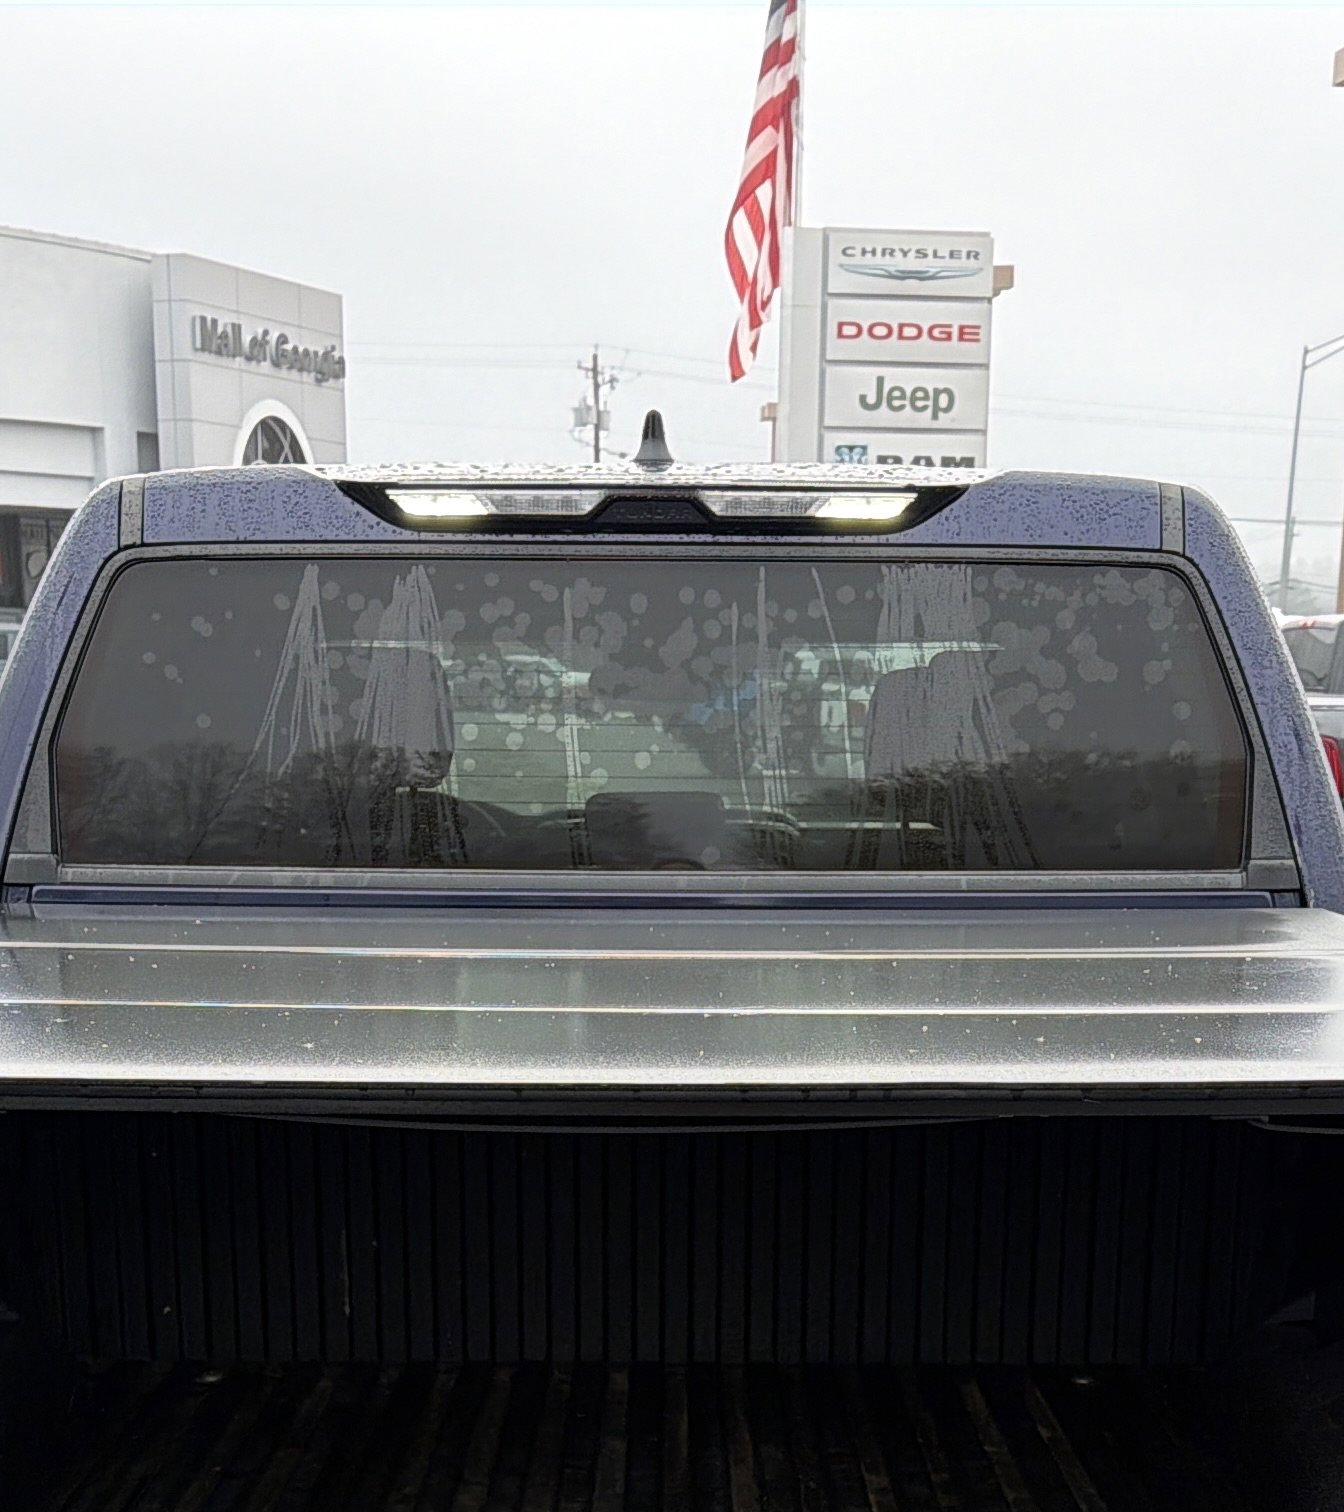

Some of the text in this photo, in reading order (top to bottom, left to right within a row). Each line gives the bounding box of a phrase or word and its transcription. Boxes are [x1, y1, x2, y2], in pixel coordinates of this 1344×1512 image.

[841, 246, 981, 261] CHRYSLER
[836, 321, 982, 343] DODGE
[192, 315, 346, 384] Mall of Georgia
[858, 375, 956, 421] Jeep
[876, 454, 976, 468] RAM
